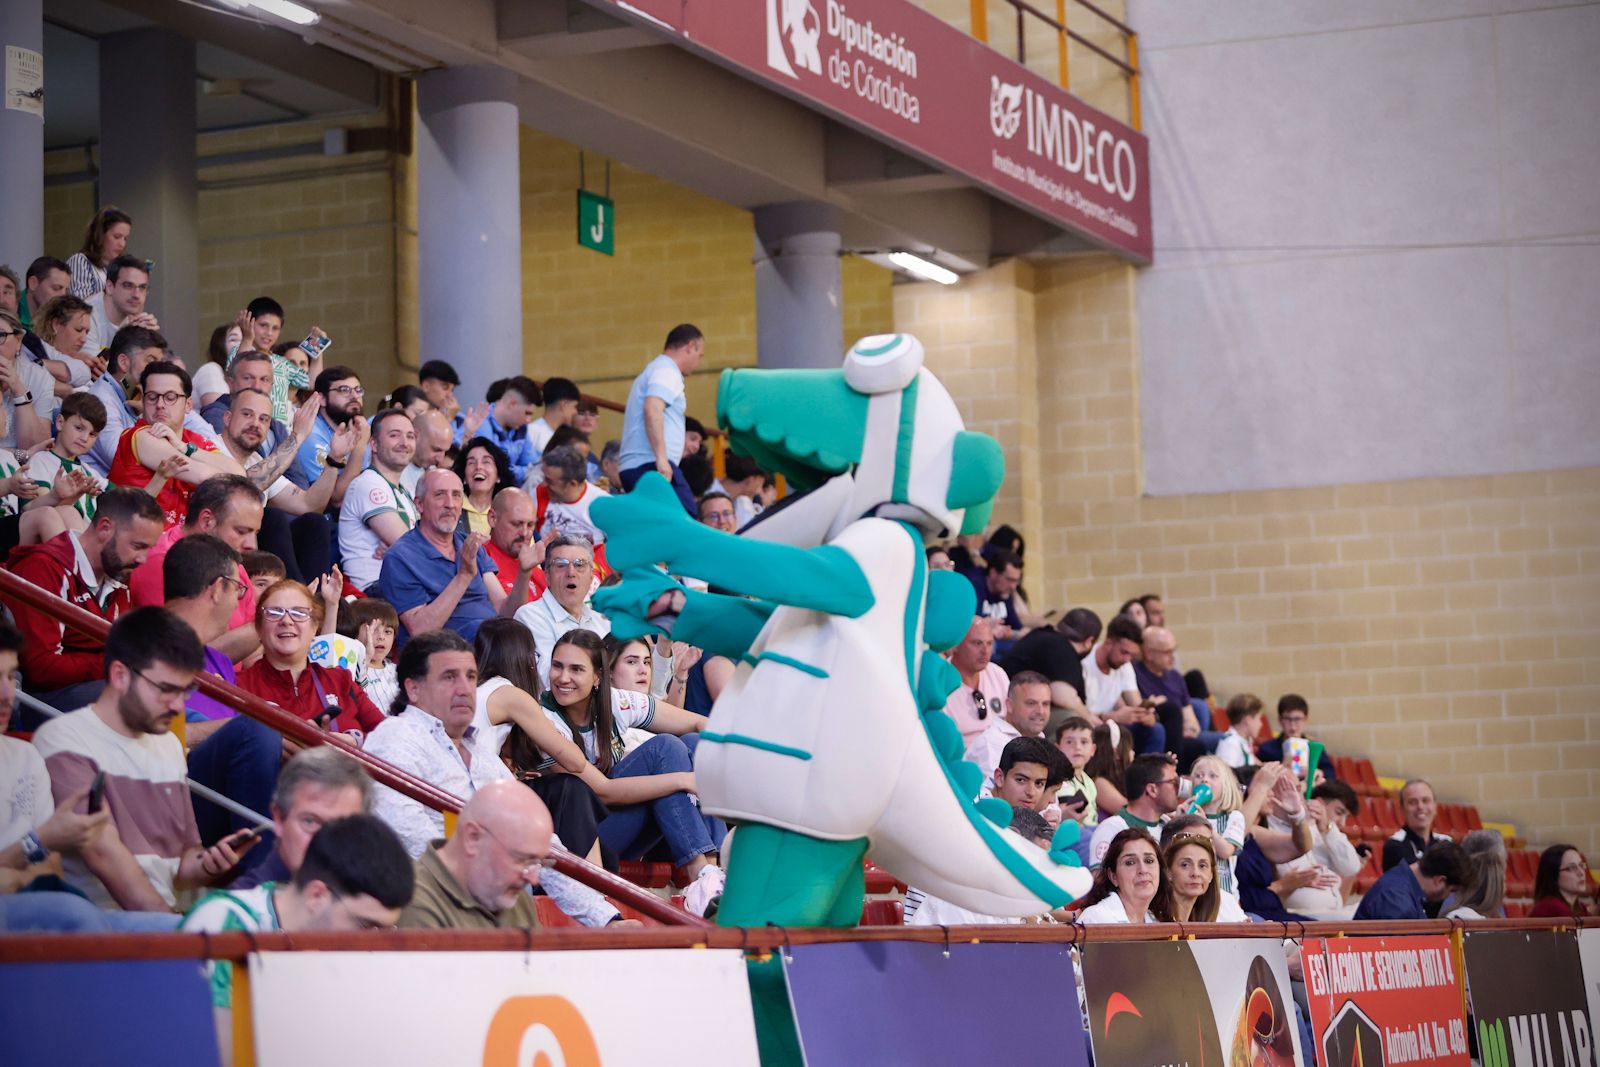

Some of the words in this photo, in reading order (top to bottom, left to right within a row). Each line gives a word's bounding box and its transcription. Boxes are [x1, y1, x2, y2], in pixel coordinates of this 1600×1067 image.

[826, 0, 918, 78] Diputación
[828, 48, 851, 89] de
[853, 59, 920, 124] Córdoba
[1025, 87, 1137, 202] IMDECO
[590, 204, 604, 243] J
[1362, 951, 1378, 991] DE
[1375, 949, 1422, 990] SERVICIOS
[1419, 948, 1447, 987] RUTA
[1445, 948, 1455, 985] 4
[1385, 1024, 1419, 1064] Autovía
[1431, 1021, 1450, 1058] Km.
[1448, 1018, 1467, 1055] 483
